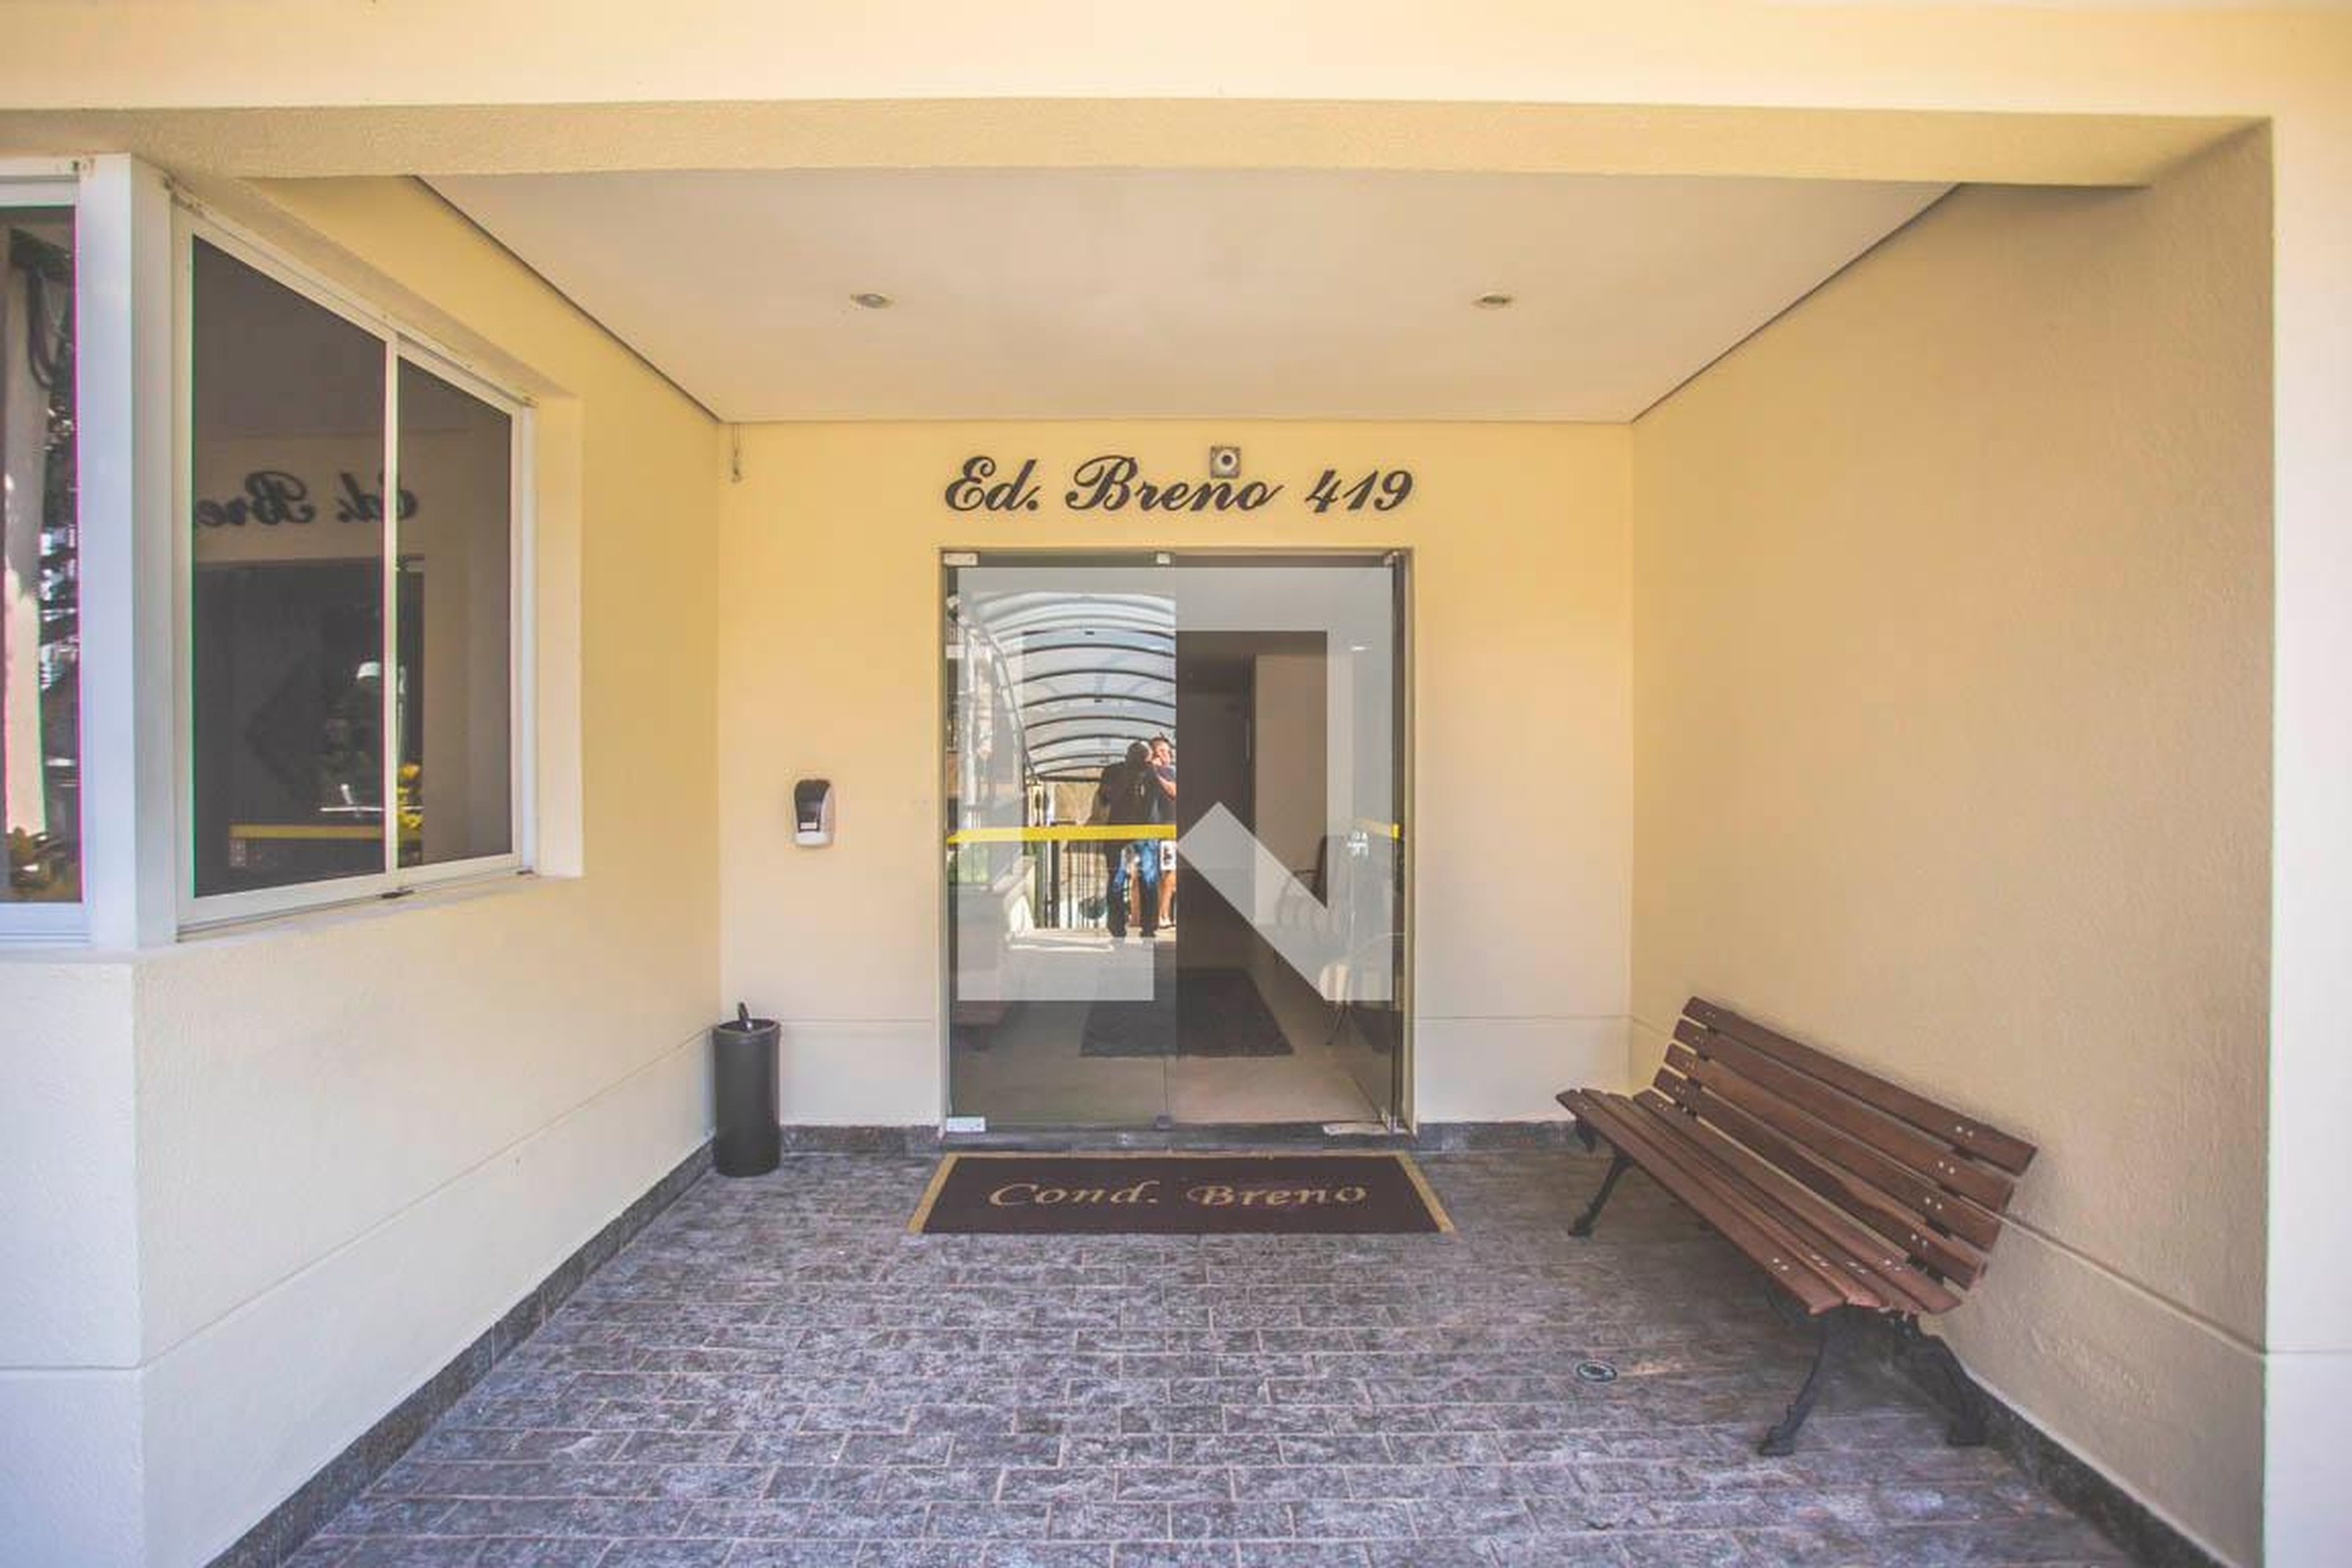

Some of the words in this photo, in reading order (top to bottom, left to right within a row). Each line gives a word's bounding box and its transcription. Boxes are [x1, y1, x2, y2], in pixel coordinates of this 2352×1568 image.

[944, 455, 1041, 512] Ed.
[1065, 454, 1284, 512] Breno
[1304, 469, 1414, 514] 419
[989, 1180, 1161, 1207] Cond.
[1186, 1185, 1368, 1207] Breno
